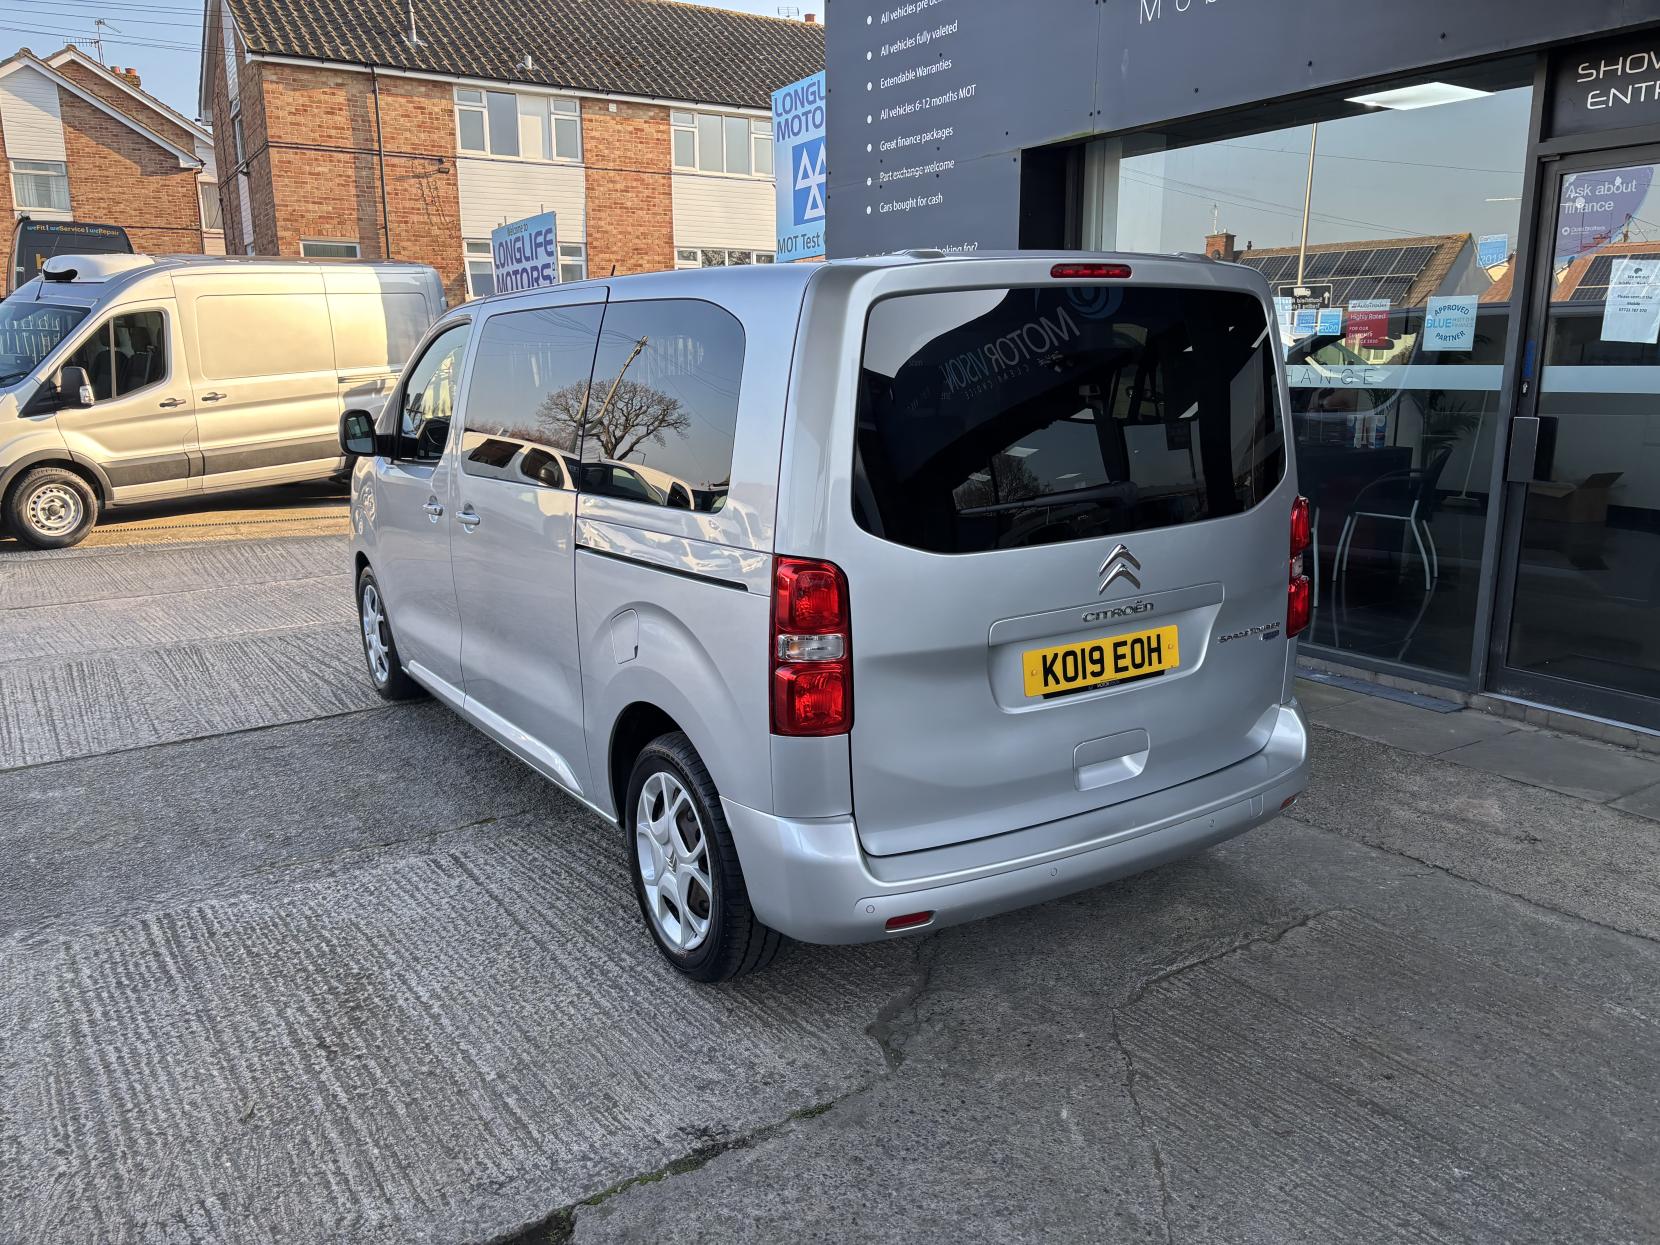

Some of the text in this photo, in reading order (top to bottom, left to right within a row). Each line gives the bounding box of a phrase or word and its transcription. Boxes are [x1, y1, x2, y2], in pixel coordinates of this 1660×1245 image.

[881, 11, 890, 24] All
[890, 4, 916, 20] vehicles
[916, 0, 929, 13] pre
[881, 20, 958, 56] All vehicles fully valeted
[880, 59, 952, 89] Extendable Warranties
[775, 79, 825, 118] LONGL
[880, 84, 977, 120] All vehicles 6-12 months MOT
[776, 106, 825, 142] MOTO
[880, 126, 954, 151] Great finance packages
[880, 160, 955, 182] Part exchange welcome
[1566, 179, 1637, 199] Ask about
[880, 192, 943, 213] Cars bought for cash
[1565, 200, 1614, 214] finance
[493, 227, 555, 269] LONGLIFE
[777, 234, 798, 255] MOT
[801, 231, 820, 250] Test
[497, 262, 553, 293] MOTORS
[1434, 304, 1470, 316] APPROVED
[1426, 318, 1453, 329] BLUE
[1435, 330, 1466, 342] PARTNER
[1042, 633, 1163, 688] KO19 EOH
